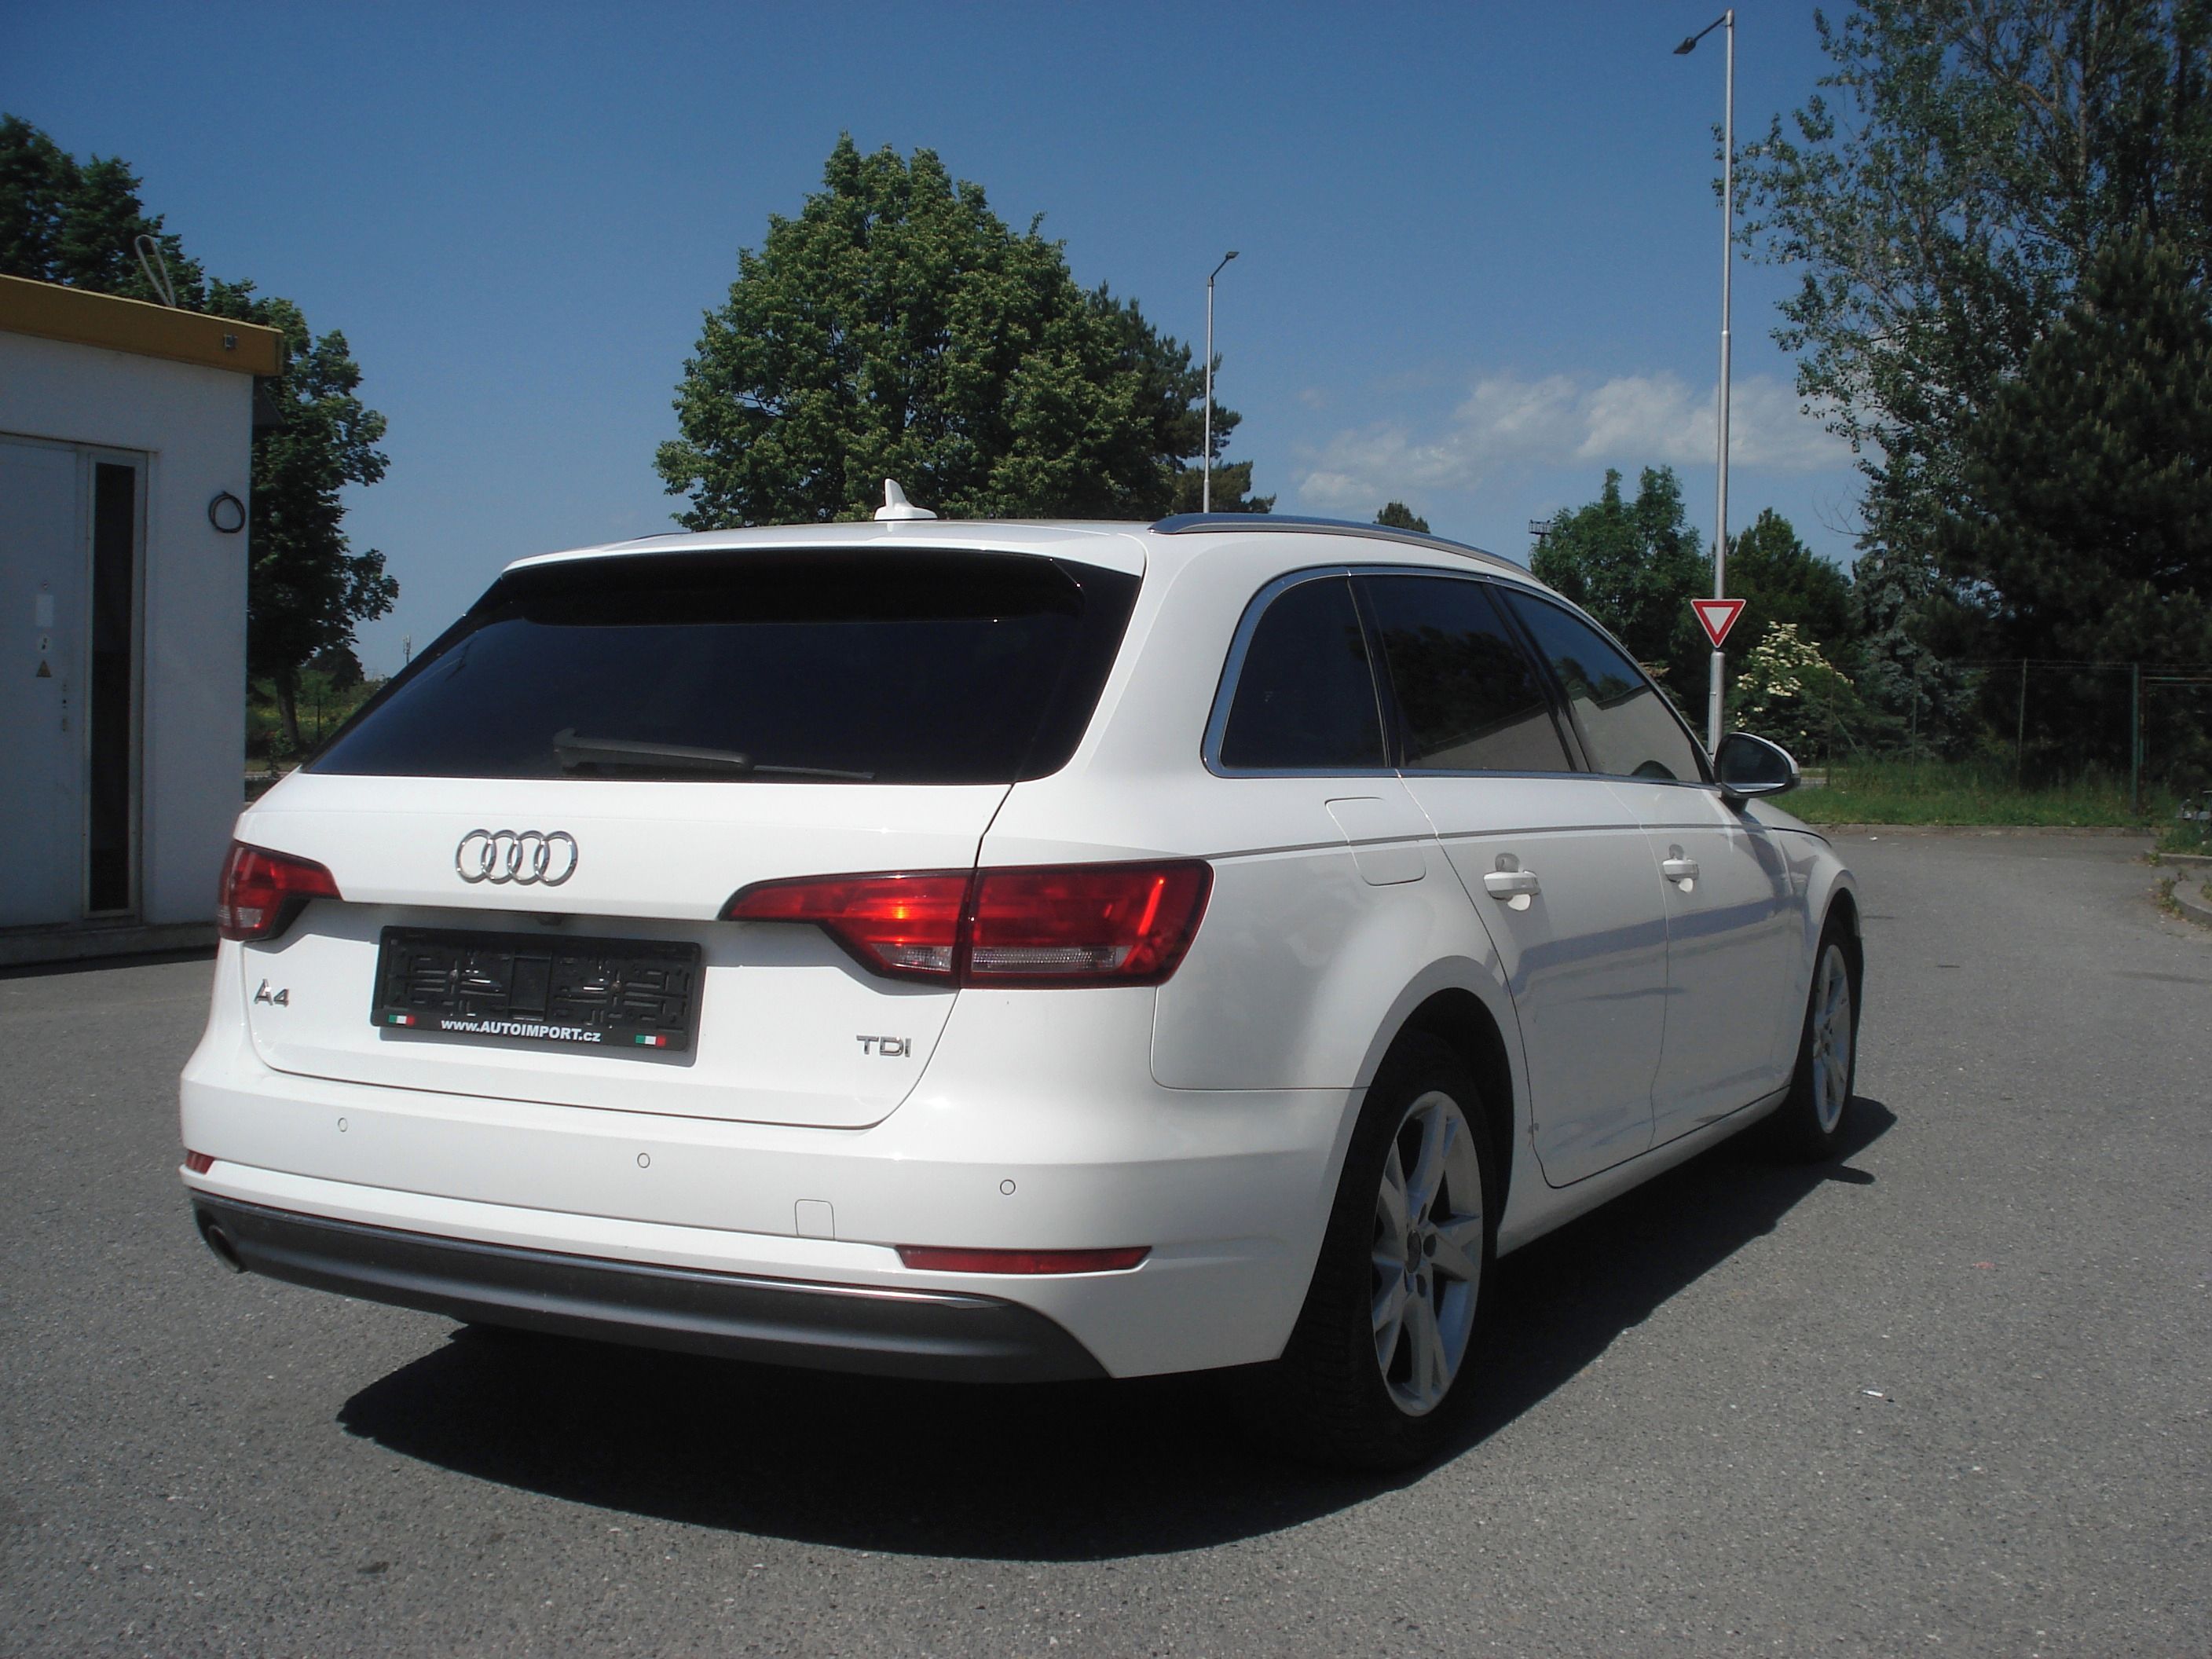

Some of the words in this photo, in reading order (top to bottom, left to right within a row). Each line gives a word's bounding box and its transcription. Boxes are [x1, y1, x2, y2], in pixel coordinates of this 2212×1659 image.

[254, 978, 289, 1008] A4
[441, 1020, 601, 1042] www.AUTOIMPORT.cz
[856, 1035, 911, 1057] TDI
